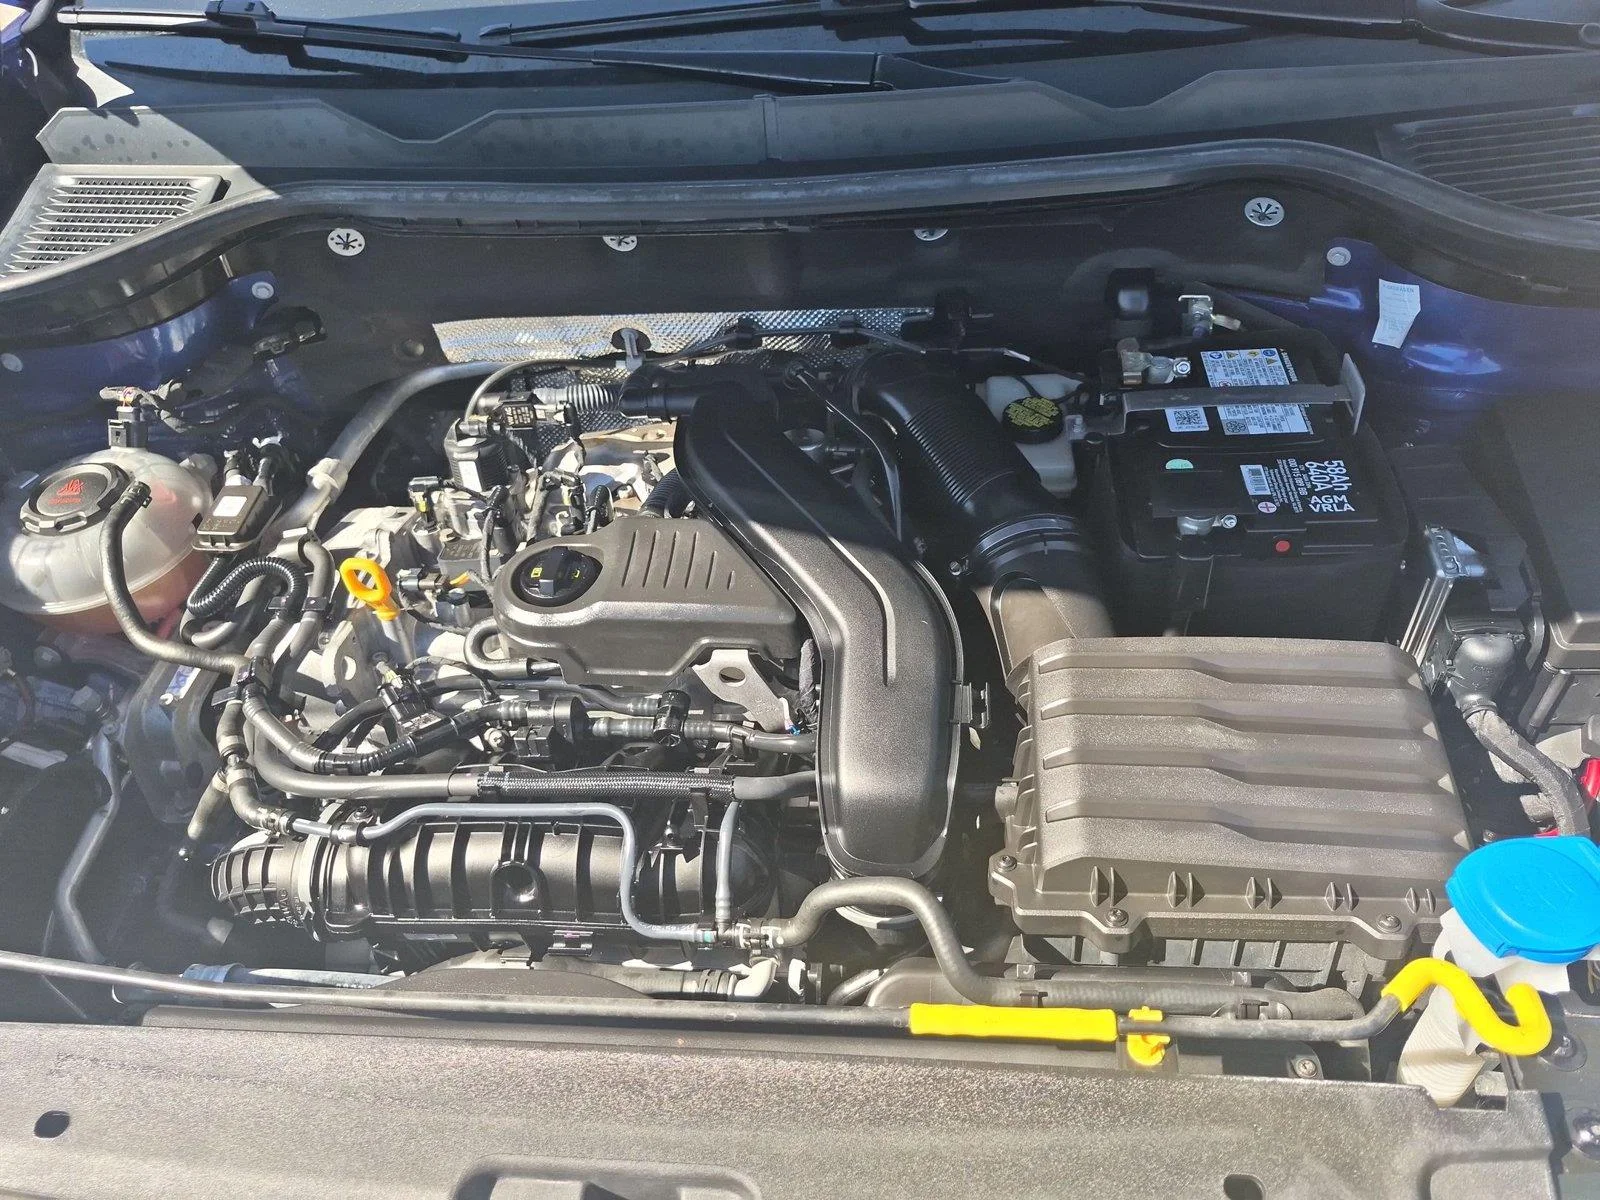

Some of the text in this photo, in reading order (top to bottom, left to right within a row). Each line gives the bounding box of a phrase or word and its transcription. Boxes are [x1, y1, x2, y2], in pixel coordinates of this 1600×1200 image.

[1305, 461, 1333, 491] 640A
[1324, 460, 1352, 491] 58Ah
[1308, 503, 1355, 513] VRLA
[1310, 494, 1348, 504] AGM
